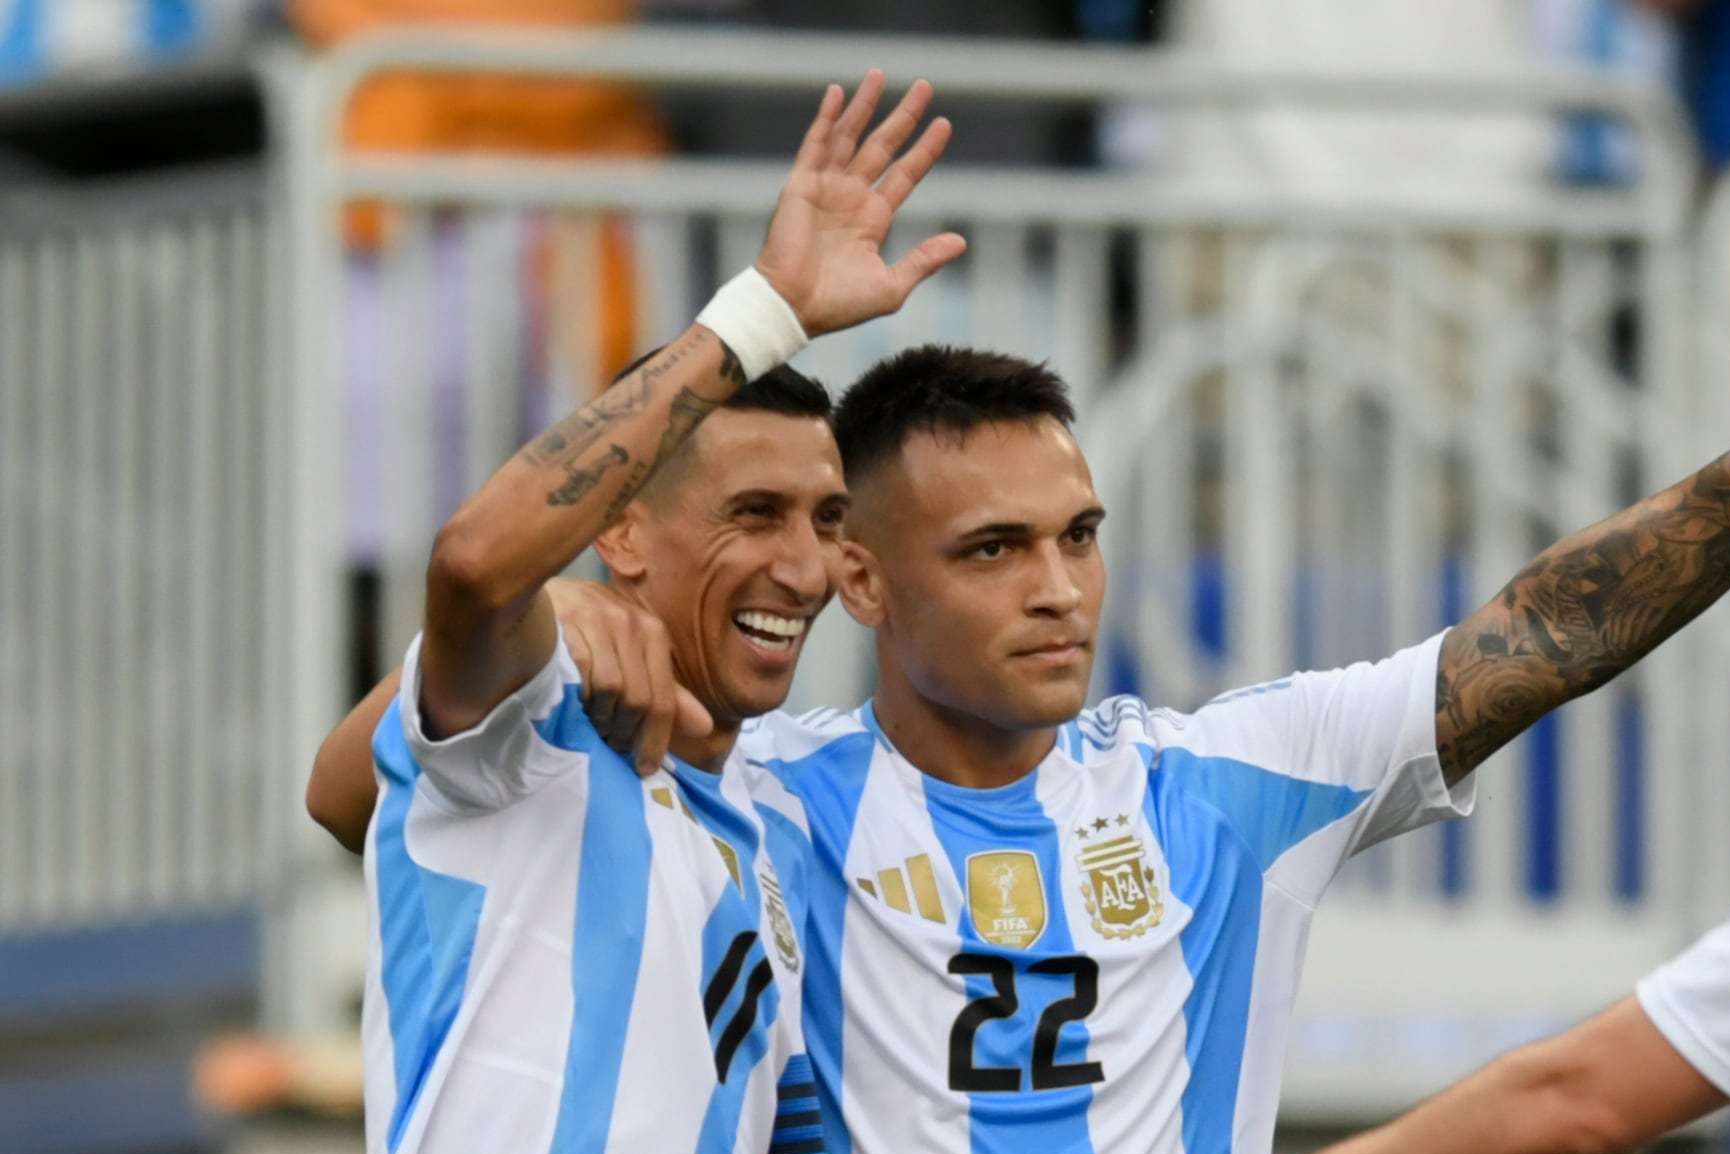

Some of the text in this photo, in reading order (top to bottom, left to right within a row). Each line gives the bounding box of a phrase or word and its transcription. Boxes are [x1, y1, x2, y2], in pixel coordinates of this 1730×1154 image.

[993, 917, 1028, 931] FIFA
[703, 929, 774, 1085] 11
[949, 954, 1104, 1091] 22
